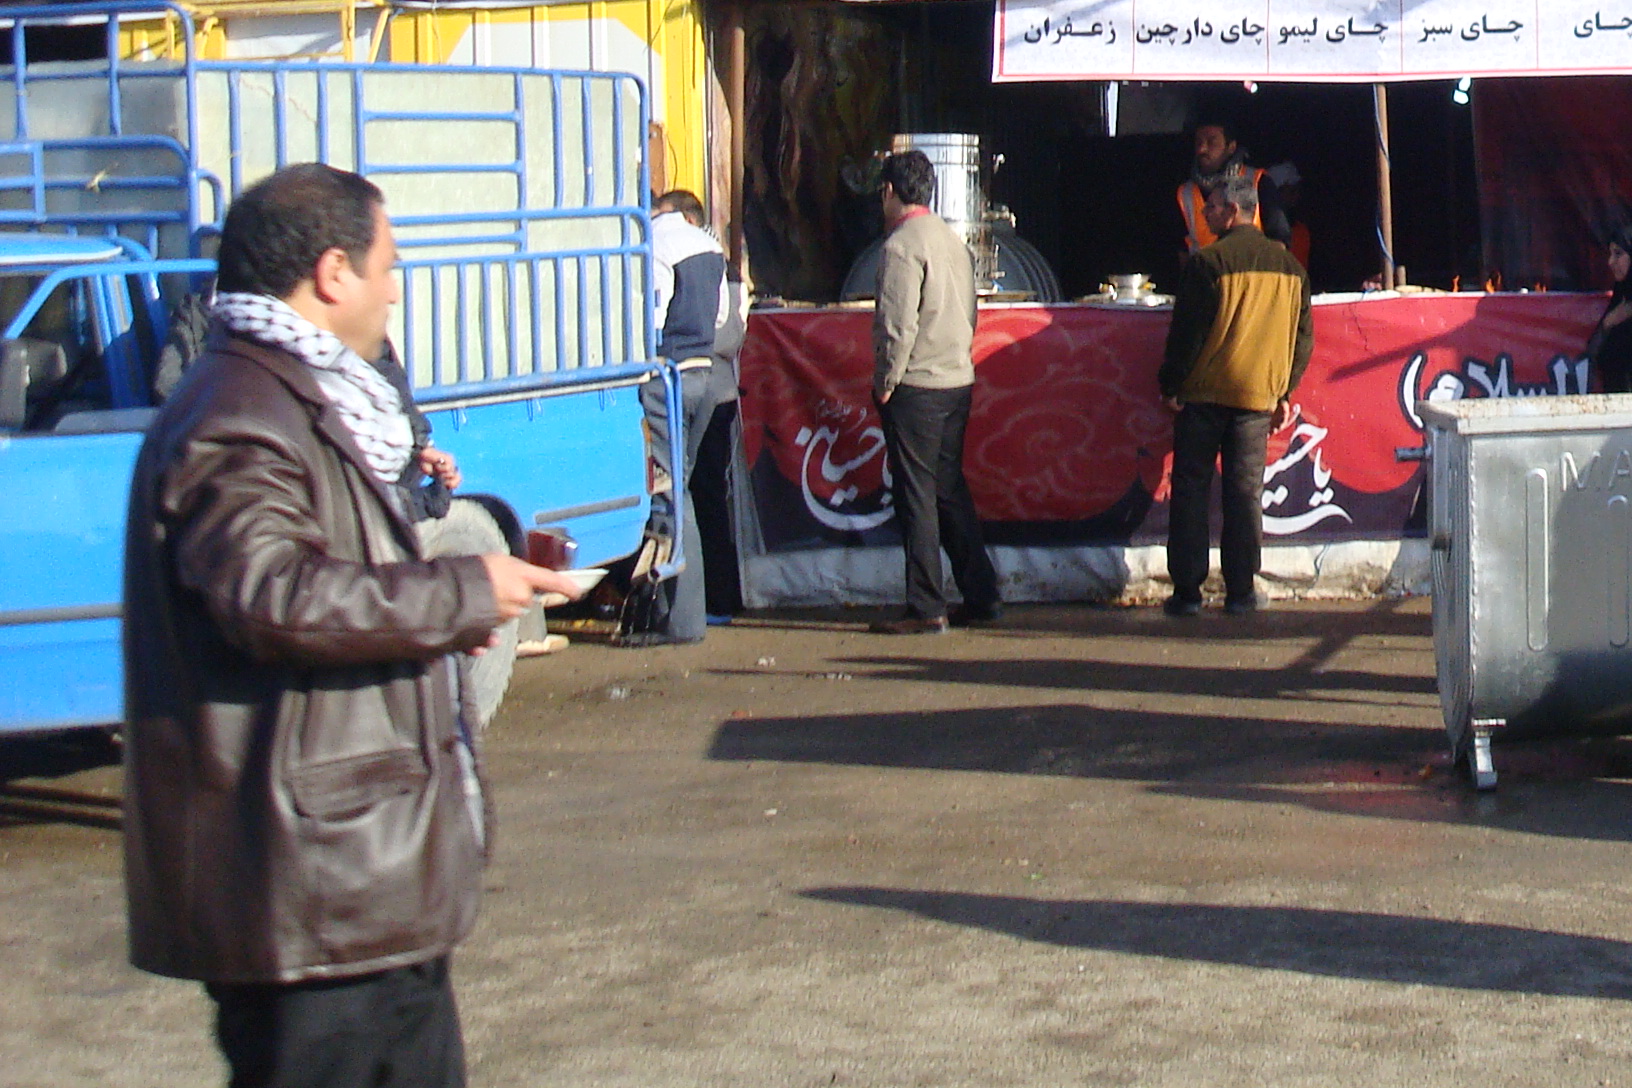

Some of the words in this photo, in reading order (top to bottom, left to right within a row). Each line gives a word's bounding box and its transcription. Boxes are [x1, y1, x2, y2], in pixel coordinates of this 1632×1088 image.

[1023, 16, 1117, 45] زعفران
[1135, 16, 1214, 46] دارچین
[1219, 16, 1265, 45] چای
[1277, 16, 1319, 45] لیمو
[1324, 16, 1389, 44] چای
[1417, 19, 1453, 43] سبز
[1460, 13, 1524, 43] چای
